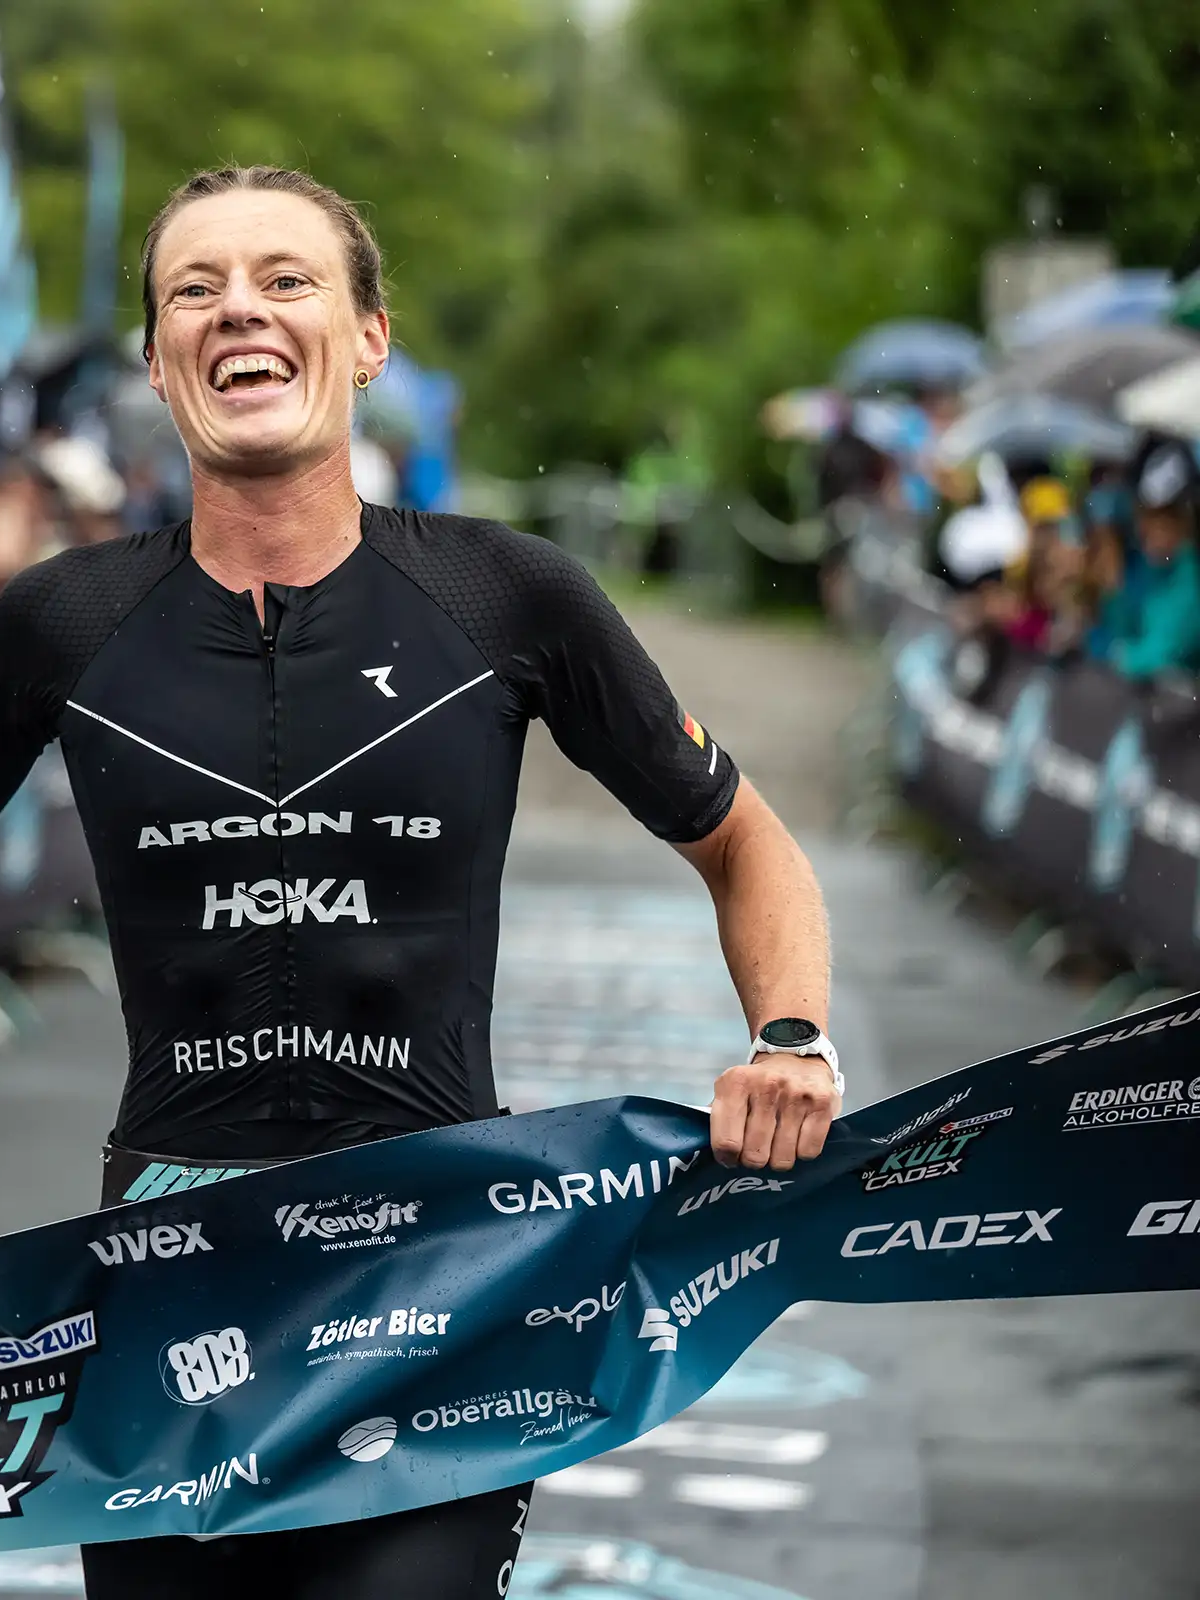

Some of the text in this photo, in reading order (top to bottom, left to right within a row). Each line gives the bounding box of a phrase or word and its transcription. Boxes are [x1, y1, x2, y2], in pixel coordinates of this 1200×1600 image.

[137, 810, 442, 850] ARGON 18
[174, 1025, 411, 1075] REISCHMANN
[1067, 1080, 1184, 1112] ERDINGER
[879, 1131, 983, 1174] KULT
[487, 1151, 701, 1215] GARMIN
[676, 1175, 795, 1217] uvex
[864, 1158, 963, 1192] CADEX
[840, 1207, 1063, 1258] CADEX
[1126, 1199, 1200, 1237] GI
[87, 1221, 214, 1266] uvex
[320, 1234, 397, 1252] www.xenofit.de
[670, 1237, 780, 1328] SUZUKI
[306, 1306, 451, 1351] Zötler Bier
[344, 1346, 406, 1361] sympathisch,
[408, 1346, 439, 1359] frisch
[411, 1388, 598, 1432] Oberallgäu
[448, 1390, 508, 1408] LANDKREIS
